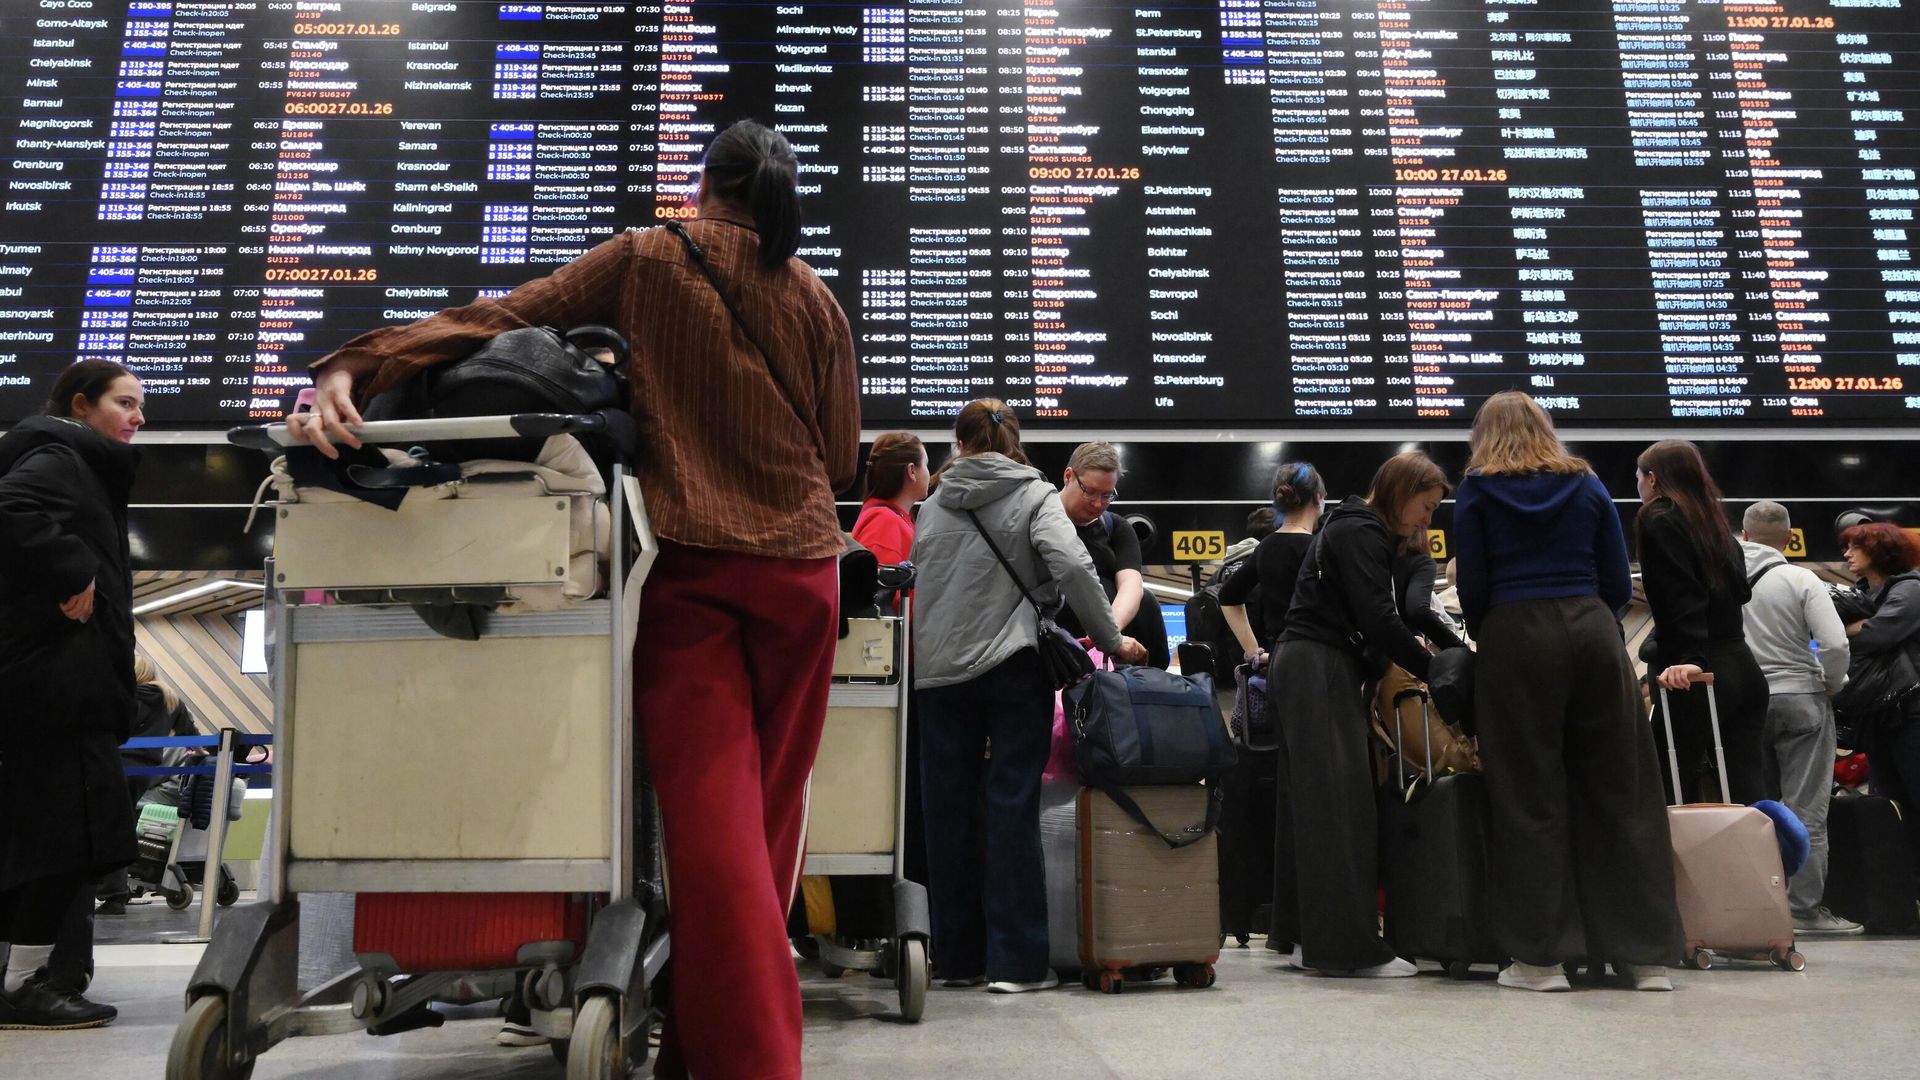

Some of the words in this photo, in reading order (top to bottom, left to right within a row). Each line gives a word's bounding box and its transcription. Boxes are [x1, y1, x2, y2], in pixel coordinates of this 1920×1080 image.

[40, 0, 65, 9] Cayo
[67, 0, 93, 8] Coco
[412, 3, 456, 12] Belgrade
[508, 5, 542, 13] 397-400
[777, 6, 803, 14] Sochi
[1135, 9, 1161, 17] Perm
[1726, 15, 1769, 28] 11:00
[1769, 16, 1835, 29] 27.01.26
[133, 29, 168, 37] 355-364
[776, 25, 831, 35] Mineralnye
[833, 26, 858, 35] Vody
[1136, 28, 1201, 38] St.Petersburg
[33, 39, 75, 47] Istanbul
[131, 41, 167, 49] 405-430
[408, 41, 448, 51] Istanbul
[776, 45, 827, 55] Volgograd
[1137, 48, 1176, 56] Istanbul
[1491, 50, 1535, 61] 阿布扎比
[30, 58, 92, 69] Chelyabinsk
[406, 61, 459, 70] Krasnodar
[775, 64, 832, 72] Vladikavkaz
[1138, 67, 1189, 75] Krasnodar
[26, 78, 58, 87] Minsk
[404, 81, 472, 90] Nizhnekamsk
[775, 84, 812, 92] Izhevsk
[999, 86, 1023, 94] 08:35
[1139, 86, 1190, 96] Volgograd
[23, 99, 63, 107] Barnaul
[775, 104, 804, 112] Kazan
[1140, 106, 1194, 116] Chongqing
[20, 119, 93, 129] Magnitogorsk
[400, 121, 441, 130] Yerevan
[774, 124, 828, 132] Murmansk
[1141, 125, 1205, 136] Ekaterinburg
[16, 139, 105, 150] Khanty-Mansiysk
[399, 142, 437, 150] Samara
[1142, 145, 1189, 156] Syktyvkar
[13, 160, 63, 170] Orenburg
[397, 162, 450, 171] Krasnodar
[1029, 167, 1072, 179] 09:00
[1076, 167, 1139, 179] 27.01.26
[1395, 169, 1438, 181] 10:00
[1441, 169, 1507, 181] 27.01.26
[9, 181, 72, 190] Novosibirsk
[395, 182, 428, 191] Sharm
[430, 182, 478, 191] el-Sheikh
[1144, 186, 1212, 196] St.Petersburg
[6, 202, 42, 210] Irkutsk
[393, 203, 452, 214] Kaliningrad
[1145, 206, 1196, 215] Astrakhan
[391, 224, 441, 235] Orenburg
[1147, 227, 1212, 236] Makhachkala
[0, 245, 41, 255] Tyumen
[389, 245, 424, 256] Nizhny
[427, 245, 479, 256] Novgorod
[1148, 247, 1187, 256] Bokhtar
[1149, 268, 1210, 279] Chelyabinsk
[385, 288, 448, 299] Chelyabinsk
[1149, 289, 1198, 300] Stavropol
[195, 311, 219, 319] 19:10
[1151, 310, 1178, 320] Sochi
[1152, 332, 1212, 341] Novosibirsk
[1153, 354, 1206, 363] Krasnodar
[1154, 375, 1224, 386] St.Petersburg
[1788, 377, 1832, 390] 12:00
[1835, 377, 1903, 390] 27.01.26
[1155, 397, 1174, 407] Ufa
[1763, 398, 1787, 406] 12:10
[1177, 536, 1221, 554] 405
